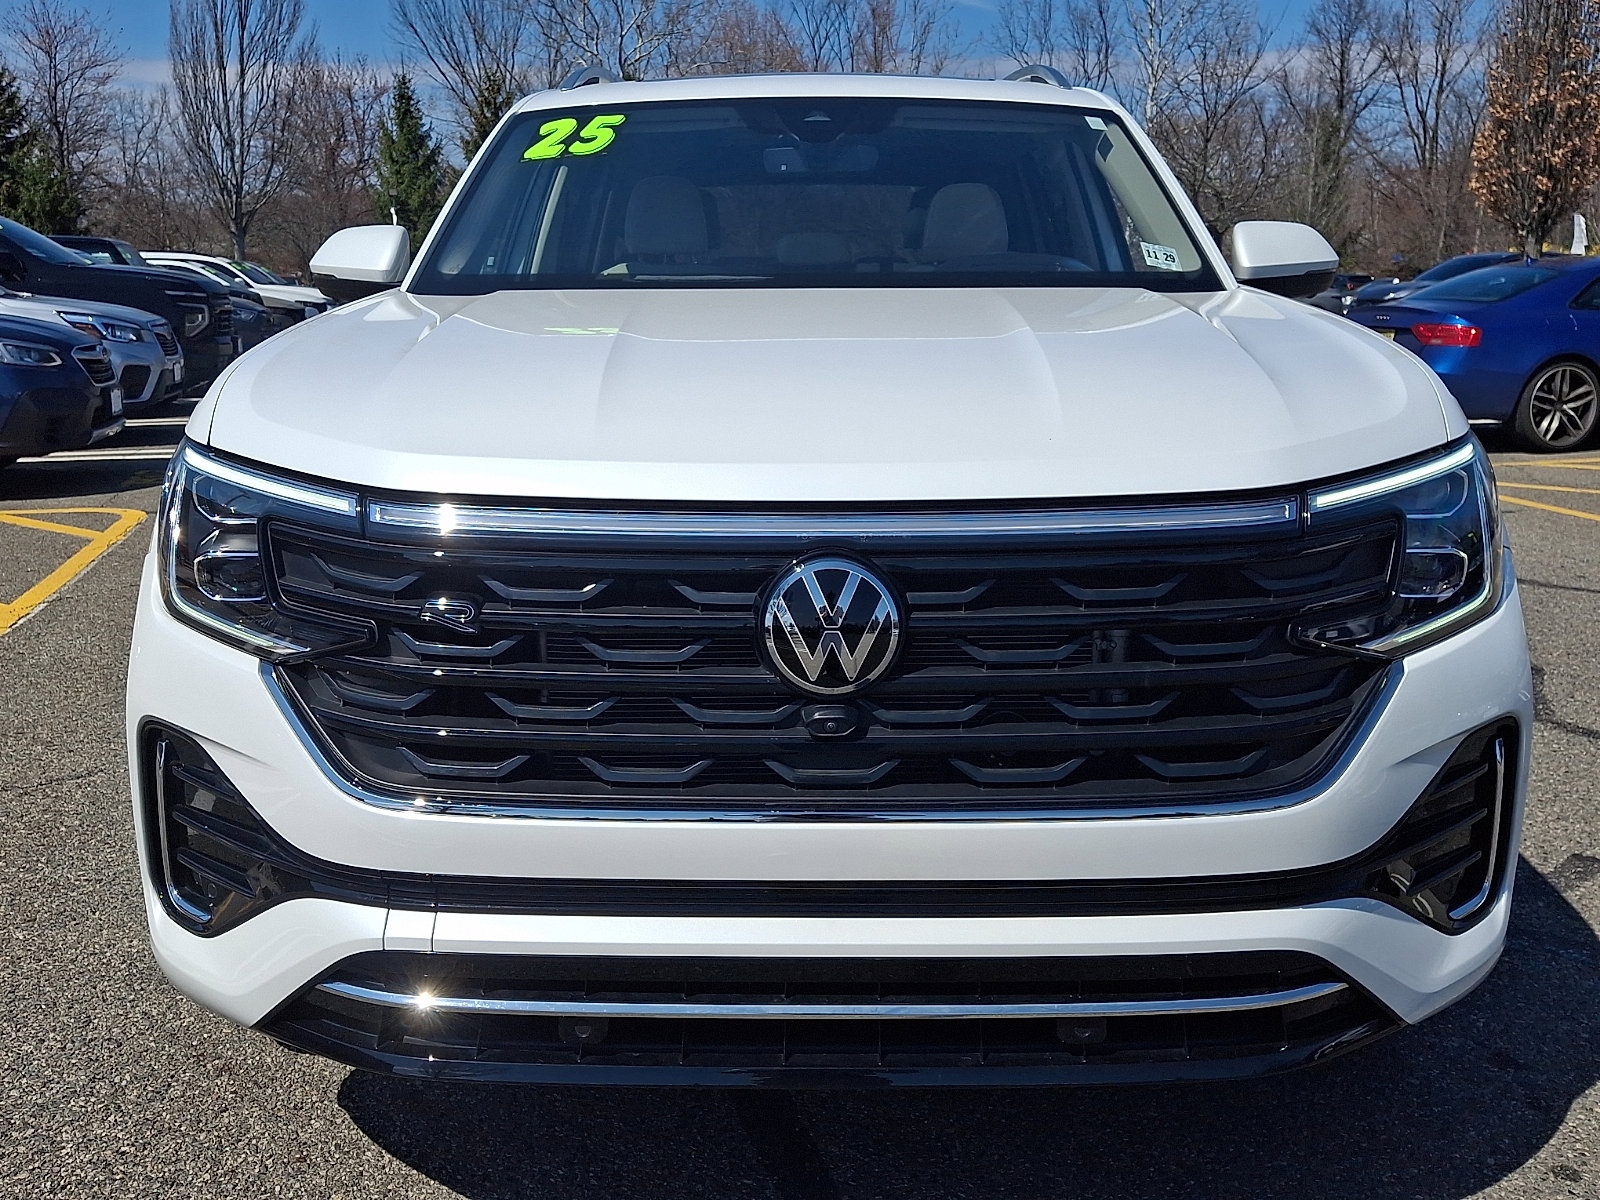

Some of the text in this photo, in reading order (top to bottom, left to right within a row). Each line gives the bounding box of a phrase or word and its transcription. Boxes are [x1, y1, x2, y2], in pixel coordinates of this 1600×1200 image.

[522, 114, 626, 160] 25
[1146, 249, 1176, 263] 11 29
